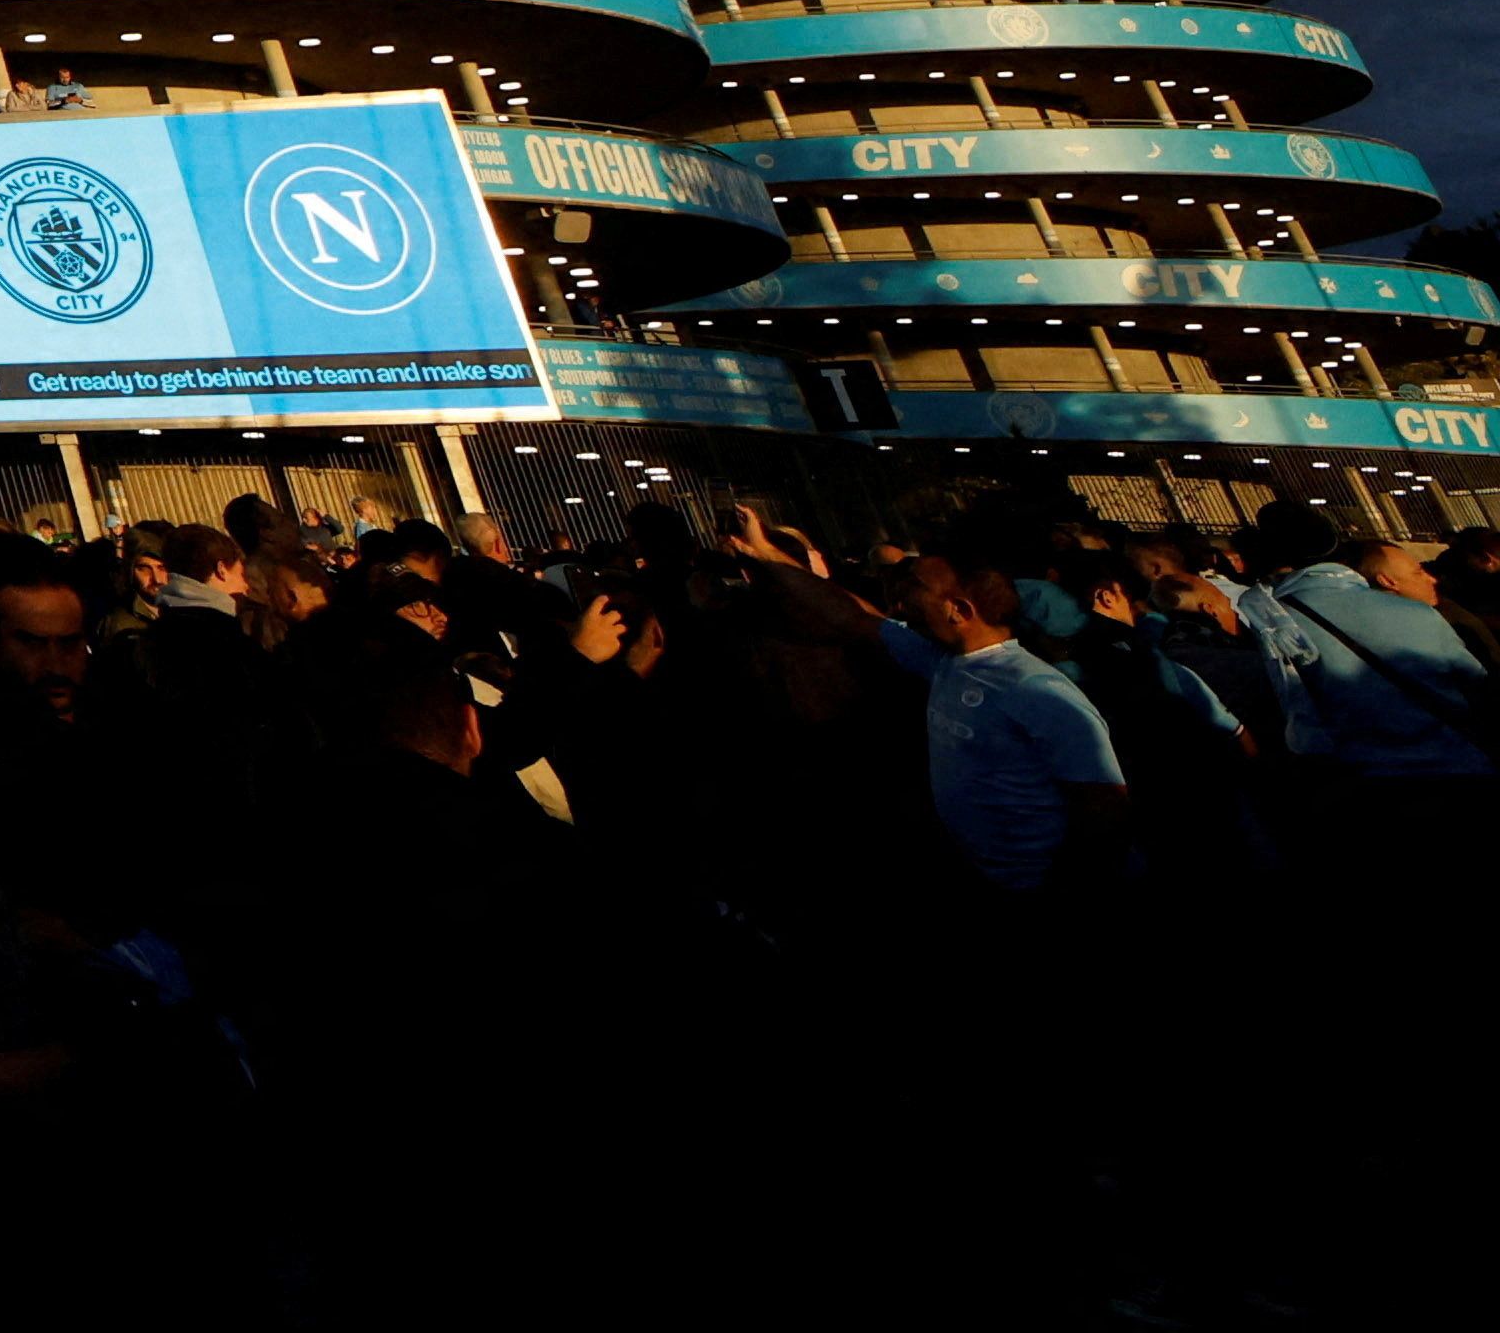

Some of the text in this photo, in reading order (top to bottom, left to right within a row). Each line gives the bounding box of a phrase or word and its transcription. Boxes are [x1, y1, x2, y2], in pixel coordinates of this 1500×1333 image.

[1295, 21, 1349, 61] CITY
[524, 133, 669, 201] OFFICIAL
[852, 136, 979, 171] CITY
[293, 190, 381, 264] N
[1121, 262, 1244, 300] CITY
[56, 293, 105, 312] CITY
[28, 360, 487, 396] Get ready to get behind the team and make
[1394, 405, 1491, 449] CITY
